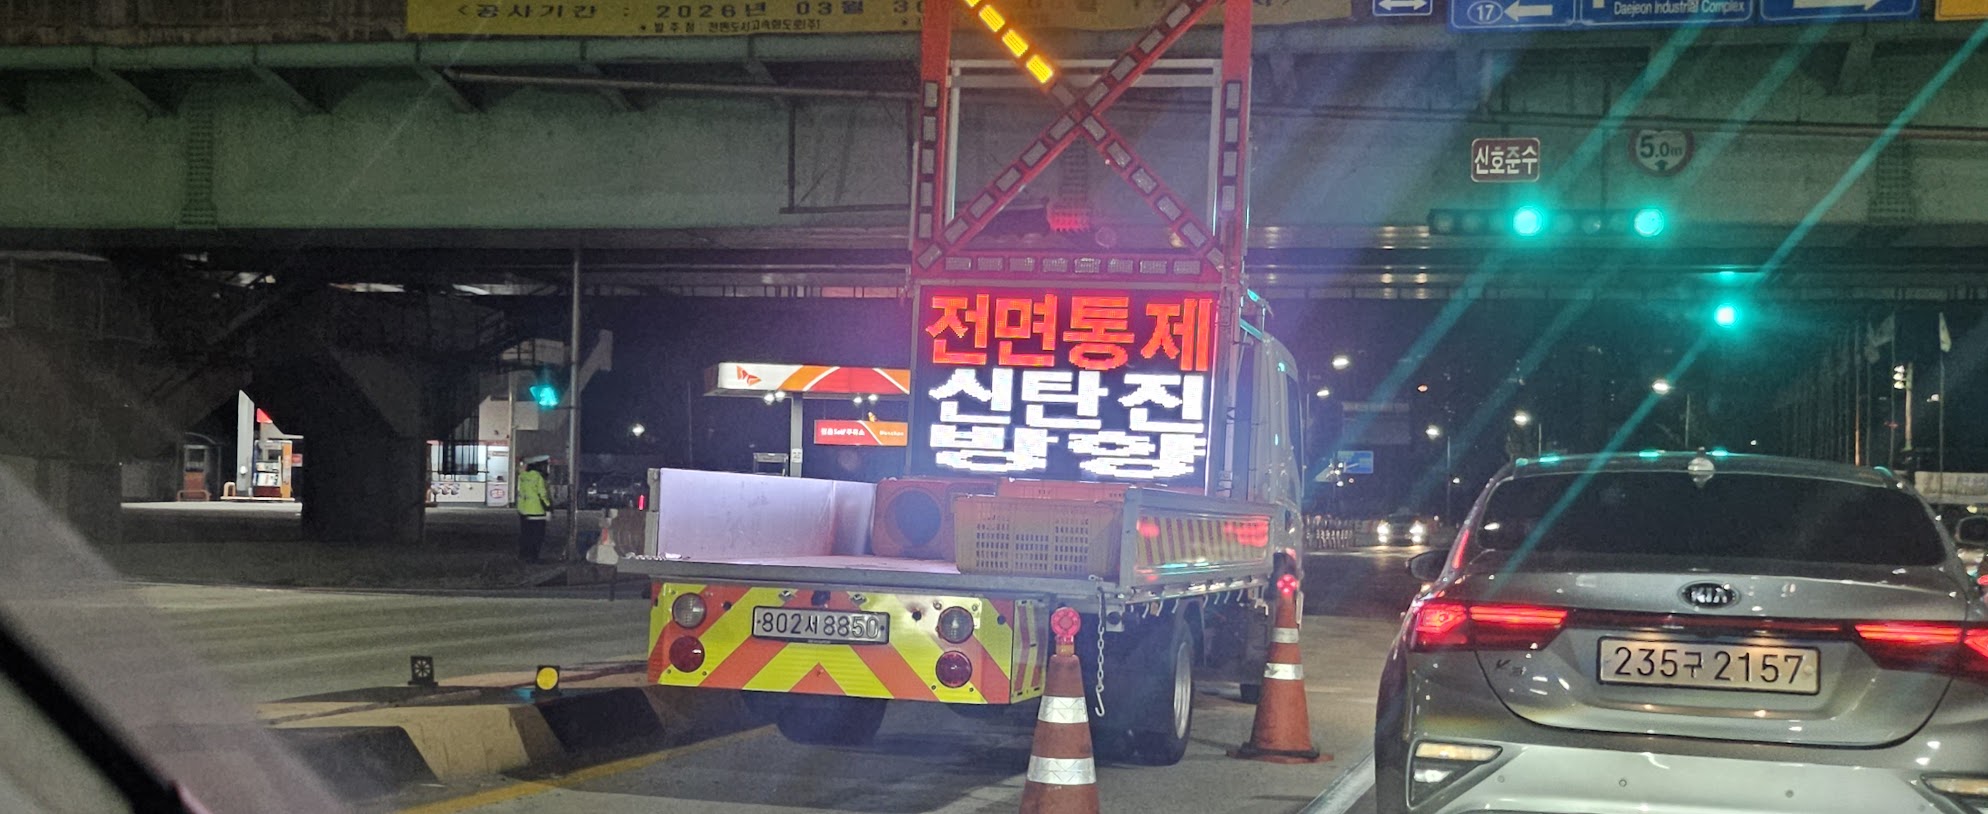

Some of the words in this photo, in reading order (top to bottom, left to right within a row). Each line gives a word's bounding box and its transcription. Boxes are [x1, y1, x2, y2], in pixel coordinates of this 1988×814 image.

[655, 1, 767, 19] 2026년
[1477, 4, 1495, 21] 17
[1613, 1, 1654, 17] Daejeon
[1654, 0, 1699, 14] Industrial
[1701, 0, 1746, 15] Complex
[1474, 145, 1538, 175] 신호준수
[1640, 135, 1683, 159] 5.0m
[925, 292, 1213, 372] 전면통제
[928, 367, 1205, 433] 신탄진
[929, 424, 1207, 479] 방향
[1691, 586, 1728, 604] KIA
[1614, 646, 1704, 678] 235구
[1714, 650, 1804, 685] 2157
